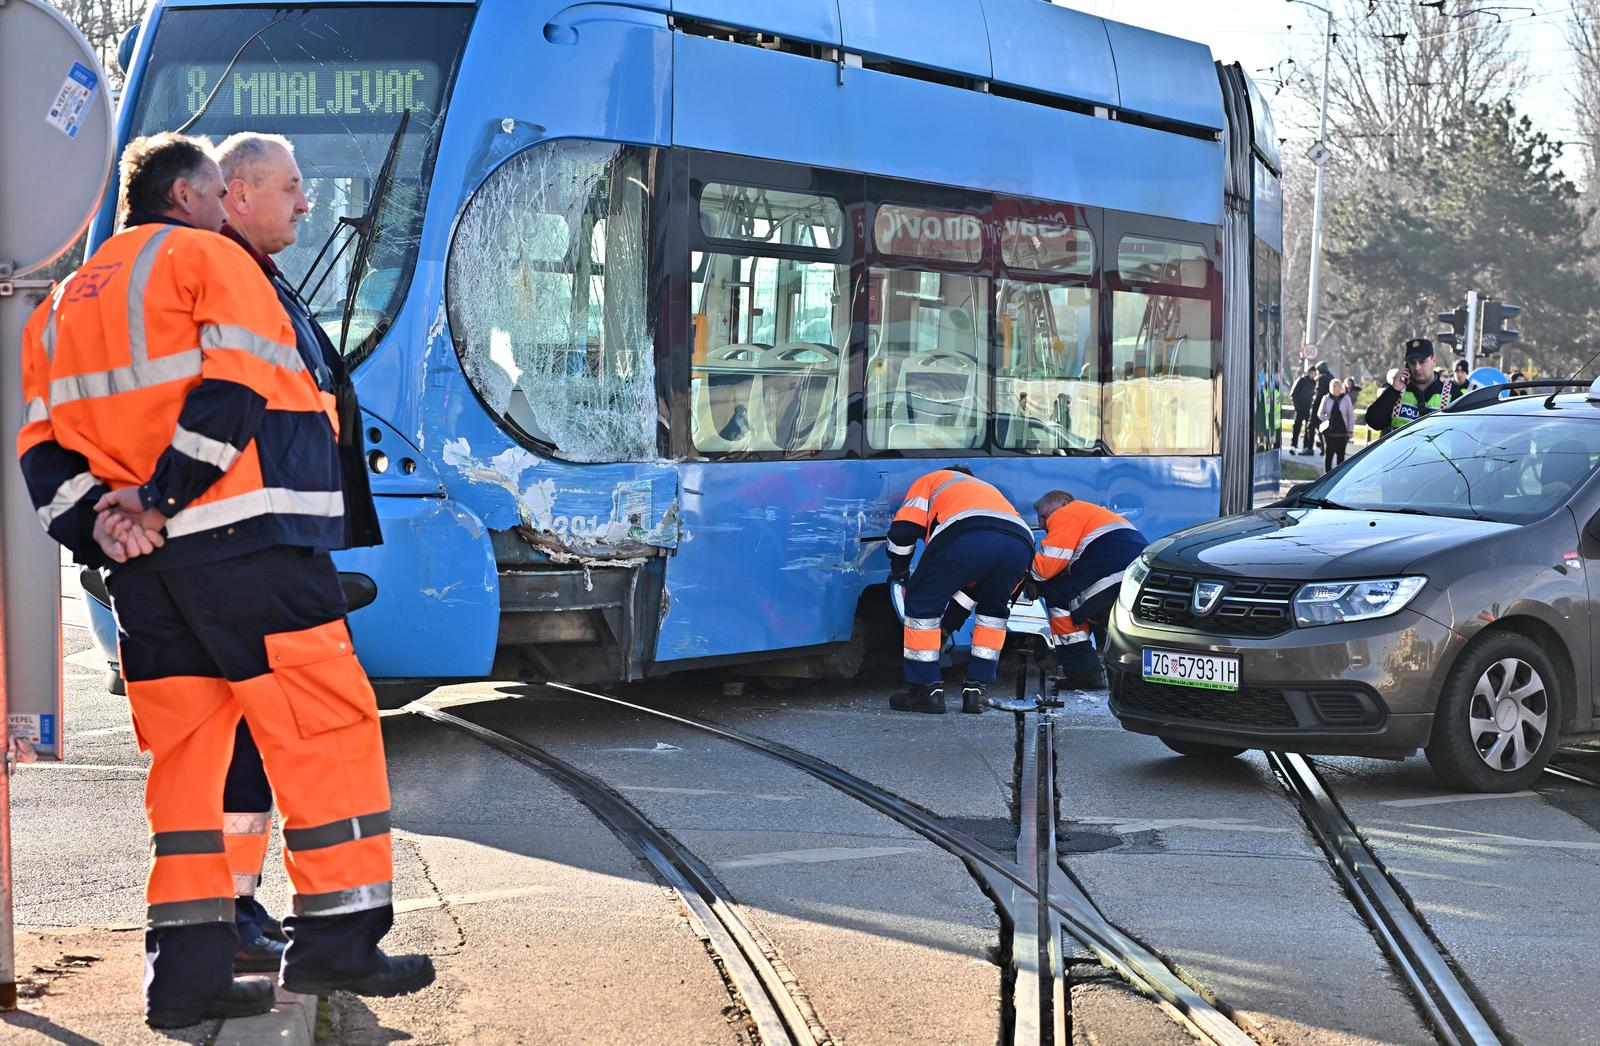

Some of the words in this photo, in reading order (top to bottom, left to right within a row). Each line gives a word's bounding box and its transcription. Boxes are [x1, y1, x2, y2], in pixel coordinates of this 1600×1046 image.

[187, 64, 206, 115] 8
[233, 69, 424, 115] MIHALJEVAC
[1400, 407, 1420, 417] POLI
[1153, 653, 1169, 675] ZG
